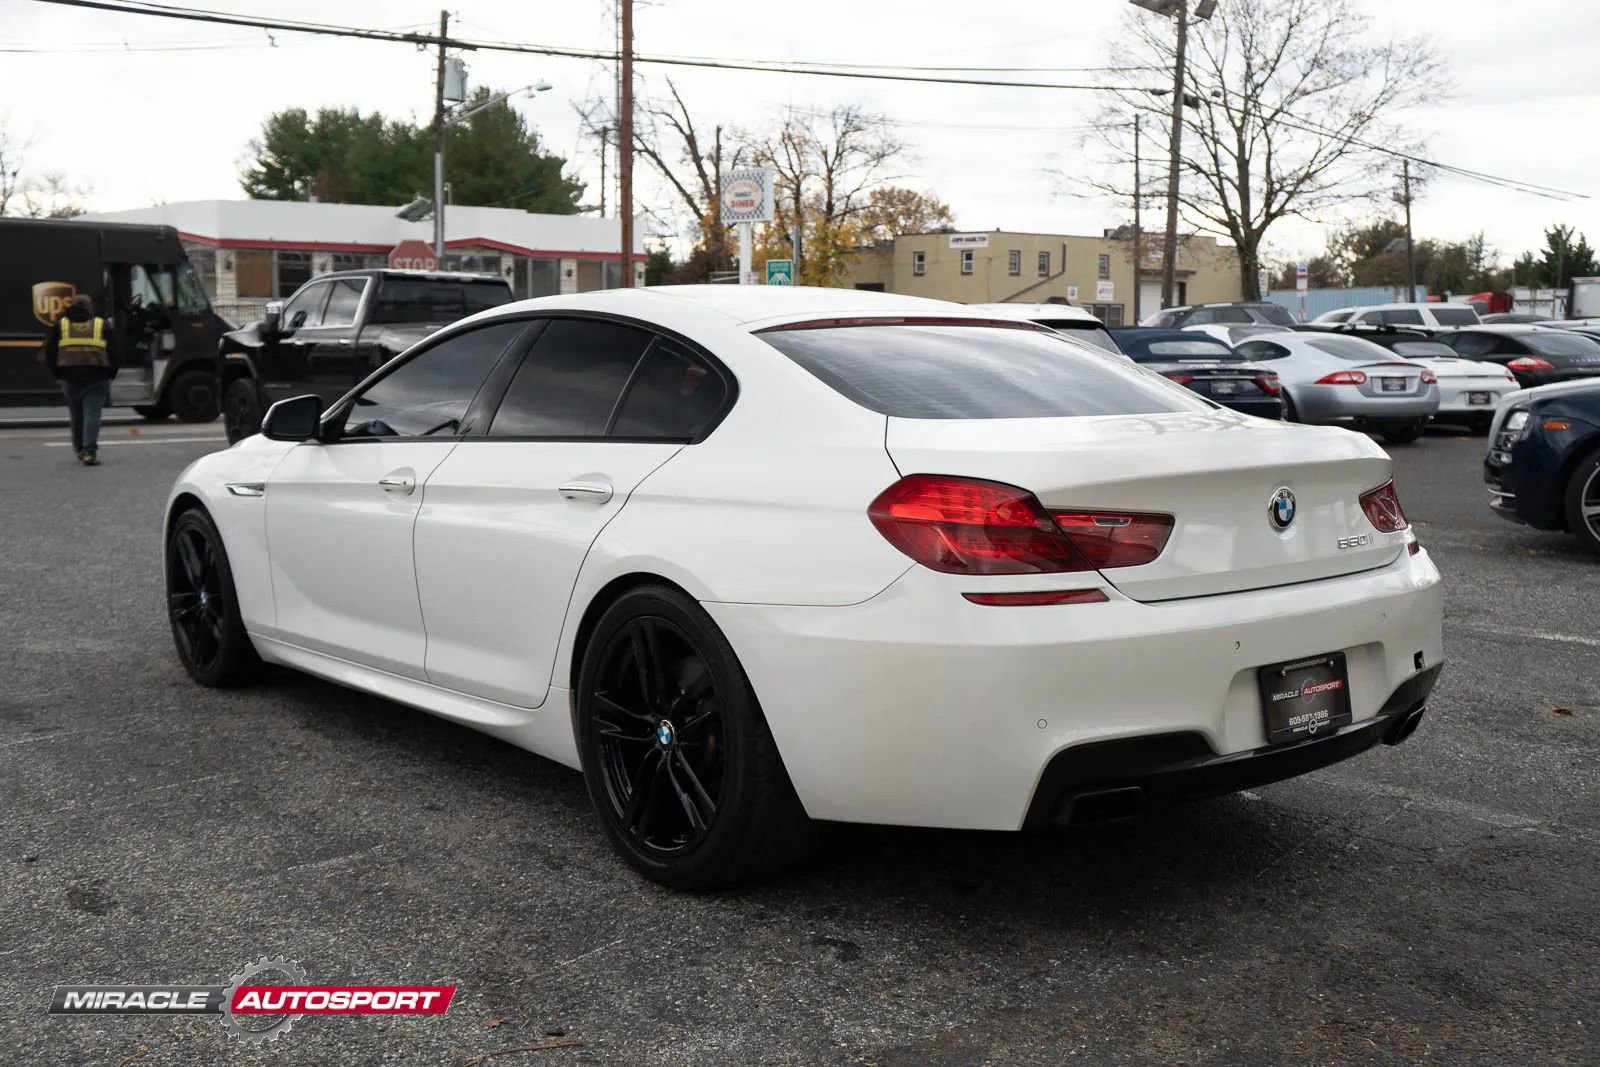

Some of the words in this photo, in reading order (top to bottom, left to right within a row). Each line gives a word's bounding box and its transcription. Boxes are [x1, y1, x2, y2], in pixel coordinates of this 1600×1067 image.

[393, 257, 435, 270] STOP
[1272, 690, 1299, 701] MIRACLE
[1303, 681, 1340, 695] AUTOSPORT
